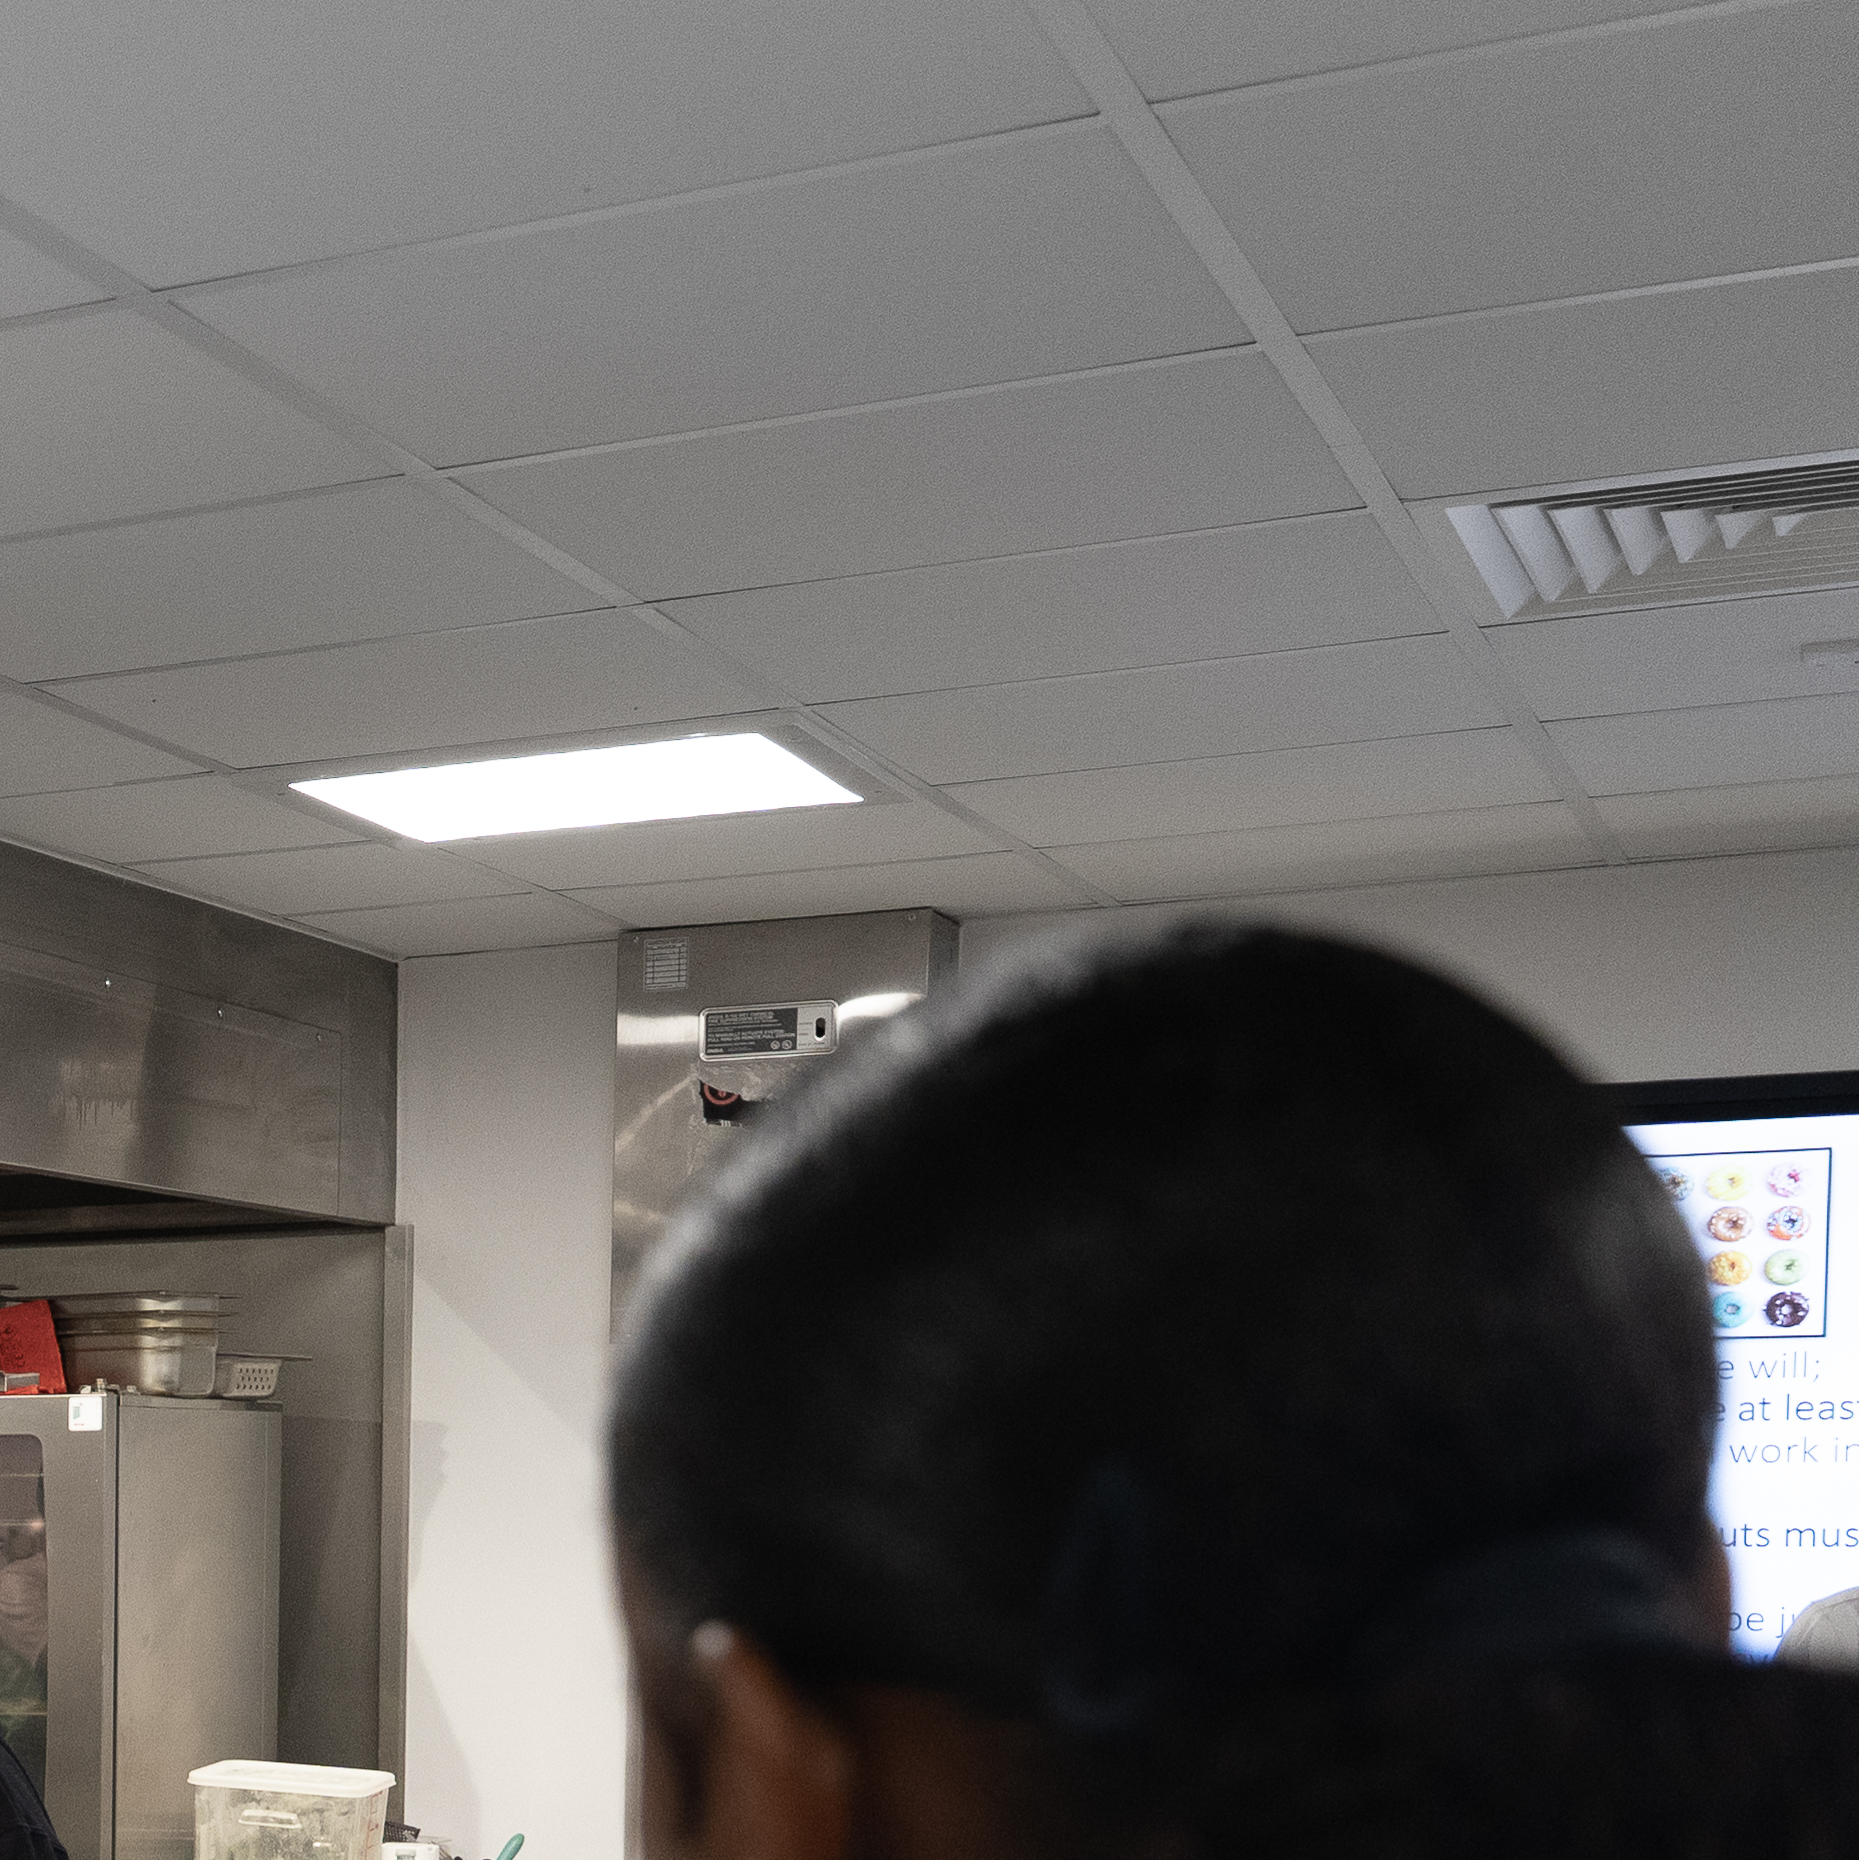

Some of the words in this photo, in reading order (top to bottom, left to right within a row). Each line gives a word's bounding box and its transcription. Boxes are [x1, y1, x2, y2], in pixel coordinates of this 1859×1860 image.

[1748, 1350, 1820, 1383] will;
[1738, 1397, 1771, 1421] at
[1786, 1393, 1859, 1421] leas
[1729, 1436, 1819, 1463] work
[1719, 1523, 1771, 1548] uts
[1785, 1527, 1859, 1548] mus
